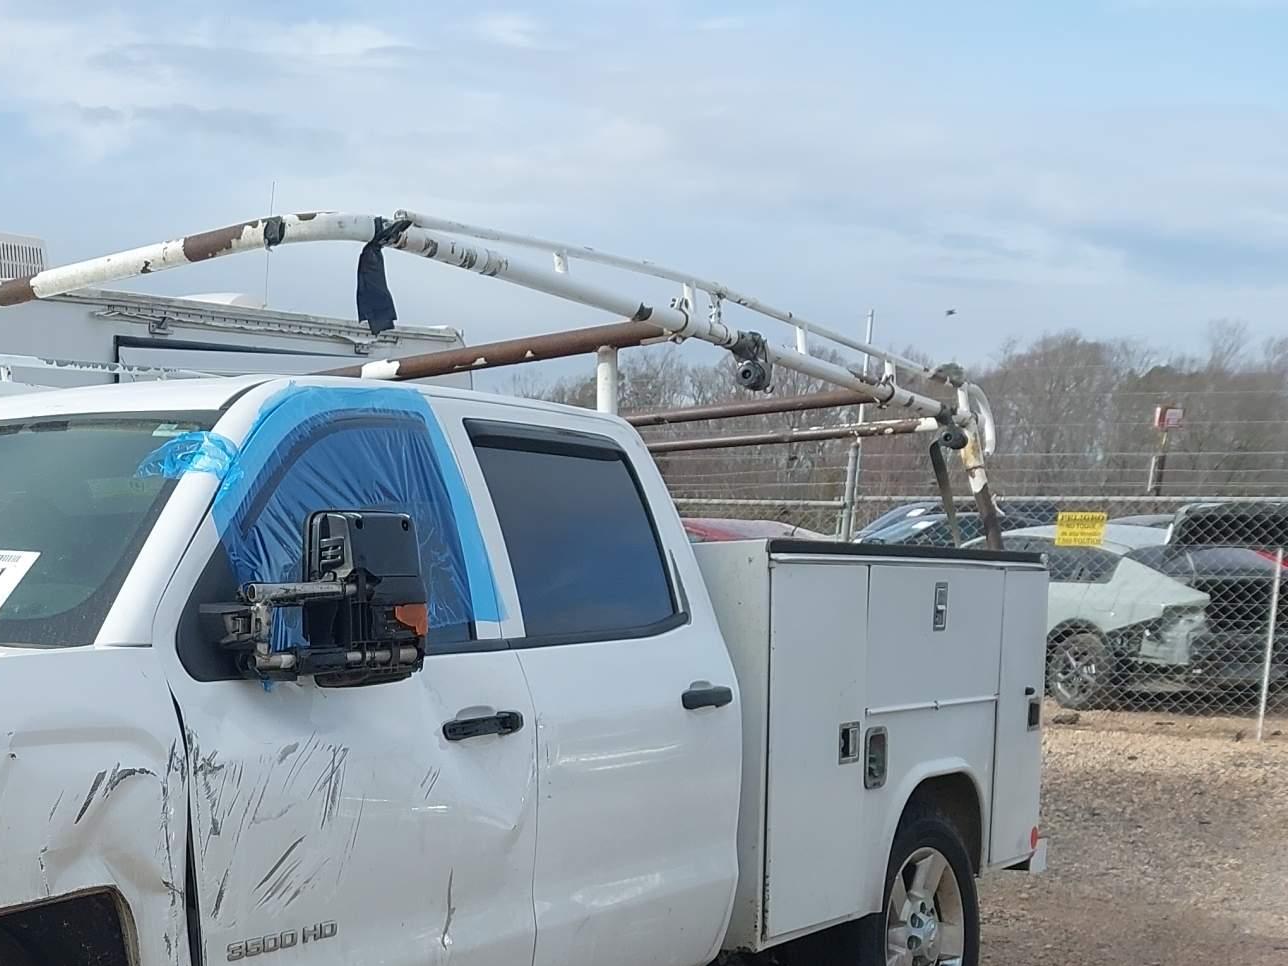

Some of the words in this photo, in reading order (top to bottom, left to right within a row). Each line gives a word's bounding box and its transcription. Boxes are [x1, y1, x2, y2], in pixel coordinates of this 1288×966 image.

[1060, 514, 1105, 522] PELIGRO
[226, 929, 298, 962] 3500
[302, 919, 338, 944] HD
